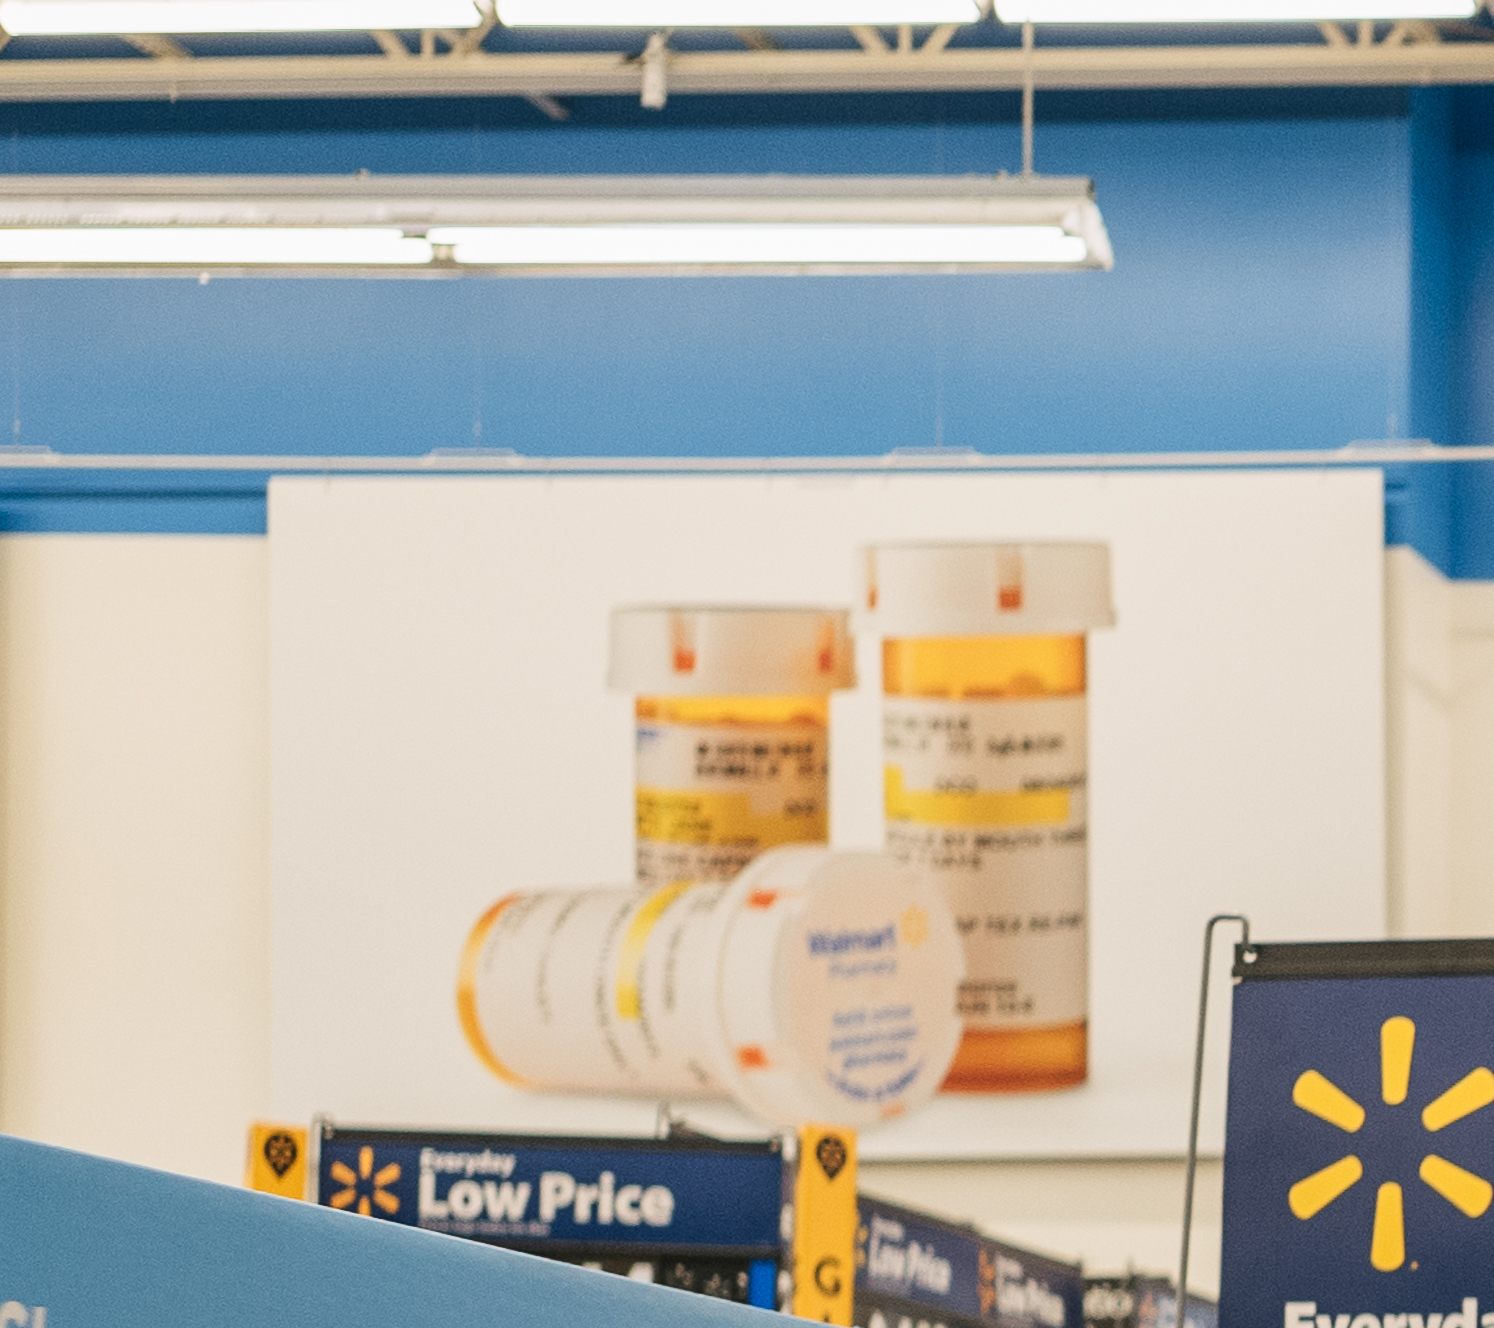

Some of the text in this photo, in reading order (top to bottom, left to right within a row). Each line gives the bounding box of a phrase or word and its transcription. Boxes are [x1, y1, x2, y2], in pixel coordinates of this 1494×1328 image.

[806, 924, 897, 957] Walmart
[419, 1147, 516, 1180] Everyday
[418, 1171, 676, 1227] Low Price
[813, 1256, 842, 1296] G
